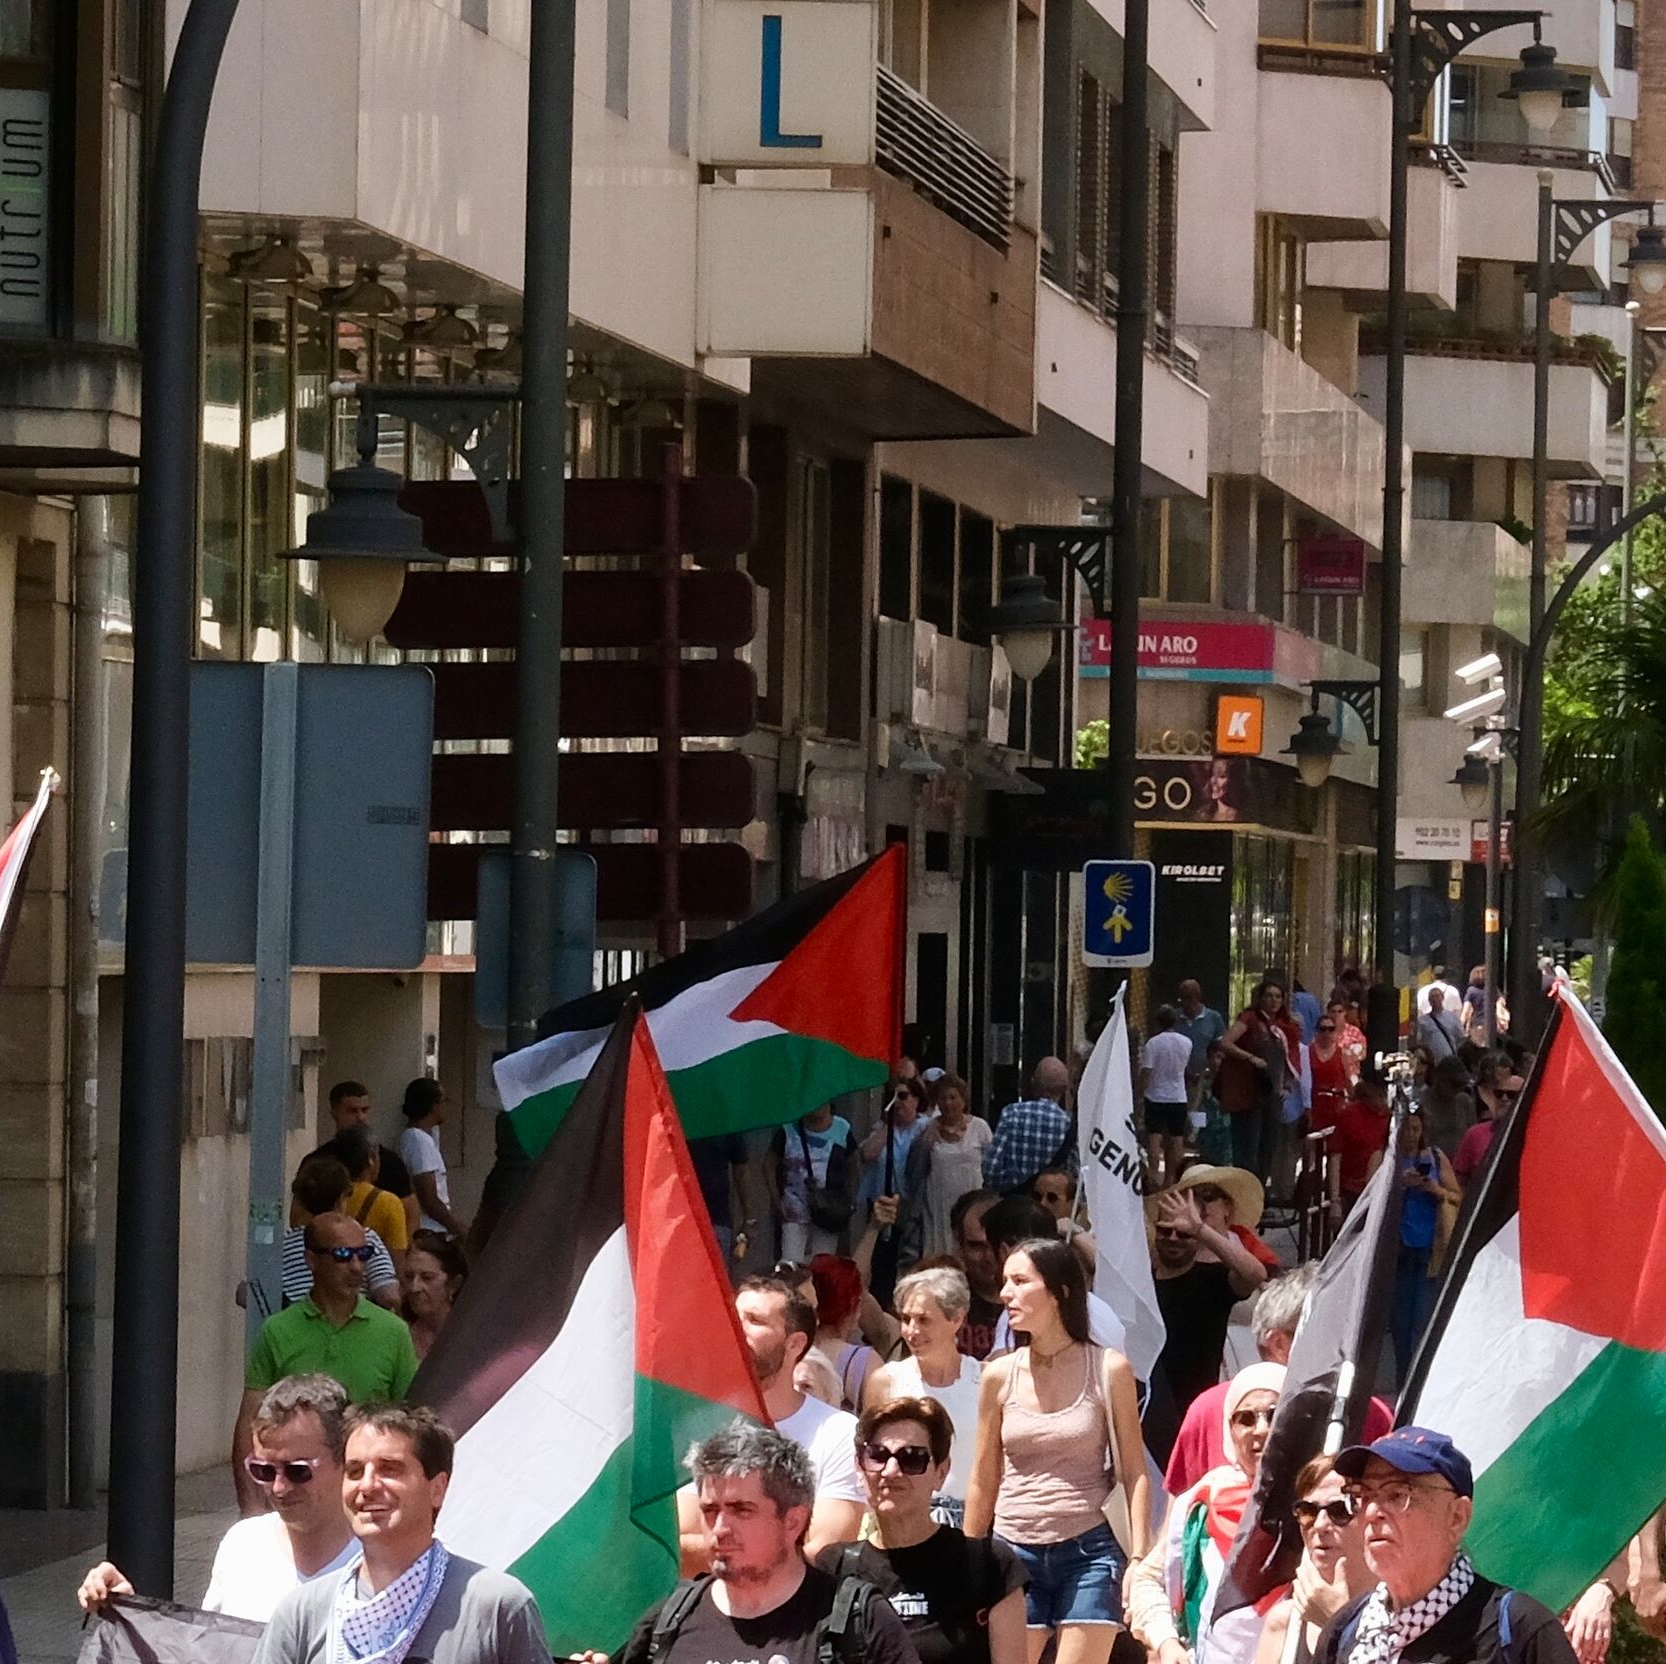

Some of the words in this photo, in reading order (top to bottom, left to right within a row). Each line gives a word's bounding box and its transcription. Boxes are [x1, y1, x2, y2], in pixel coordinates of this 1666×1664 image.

[760, 15, 822, 148] L
[1163, 635, 1199, 654] ARO
[1227, 711, 1252, 738] K
[1161, 864, 1225, 876] KIROLBET
